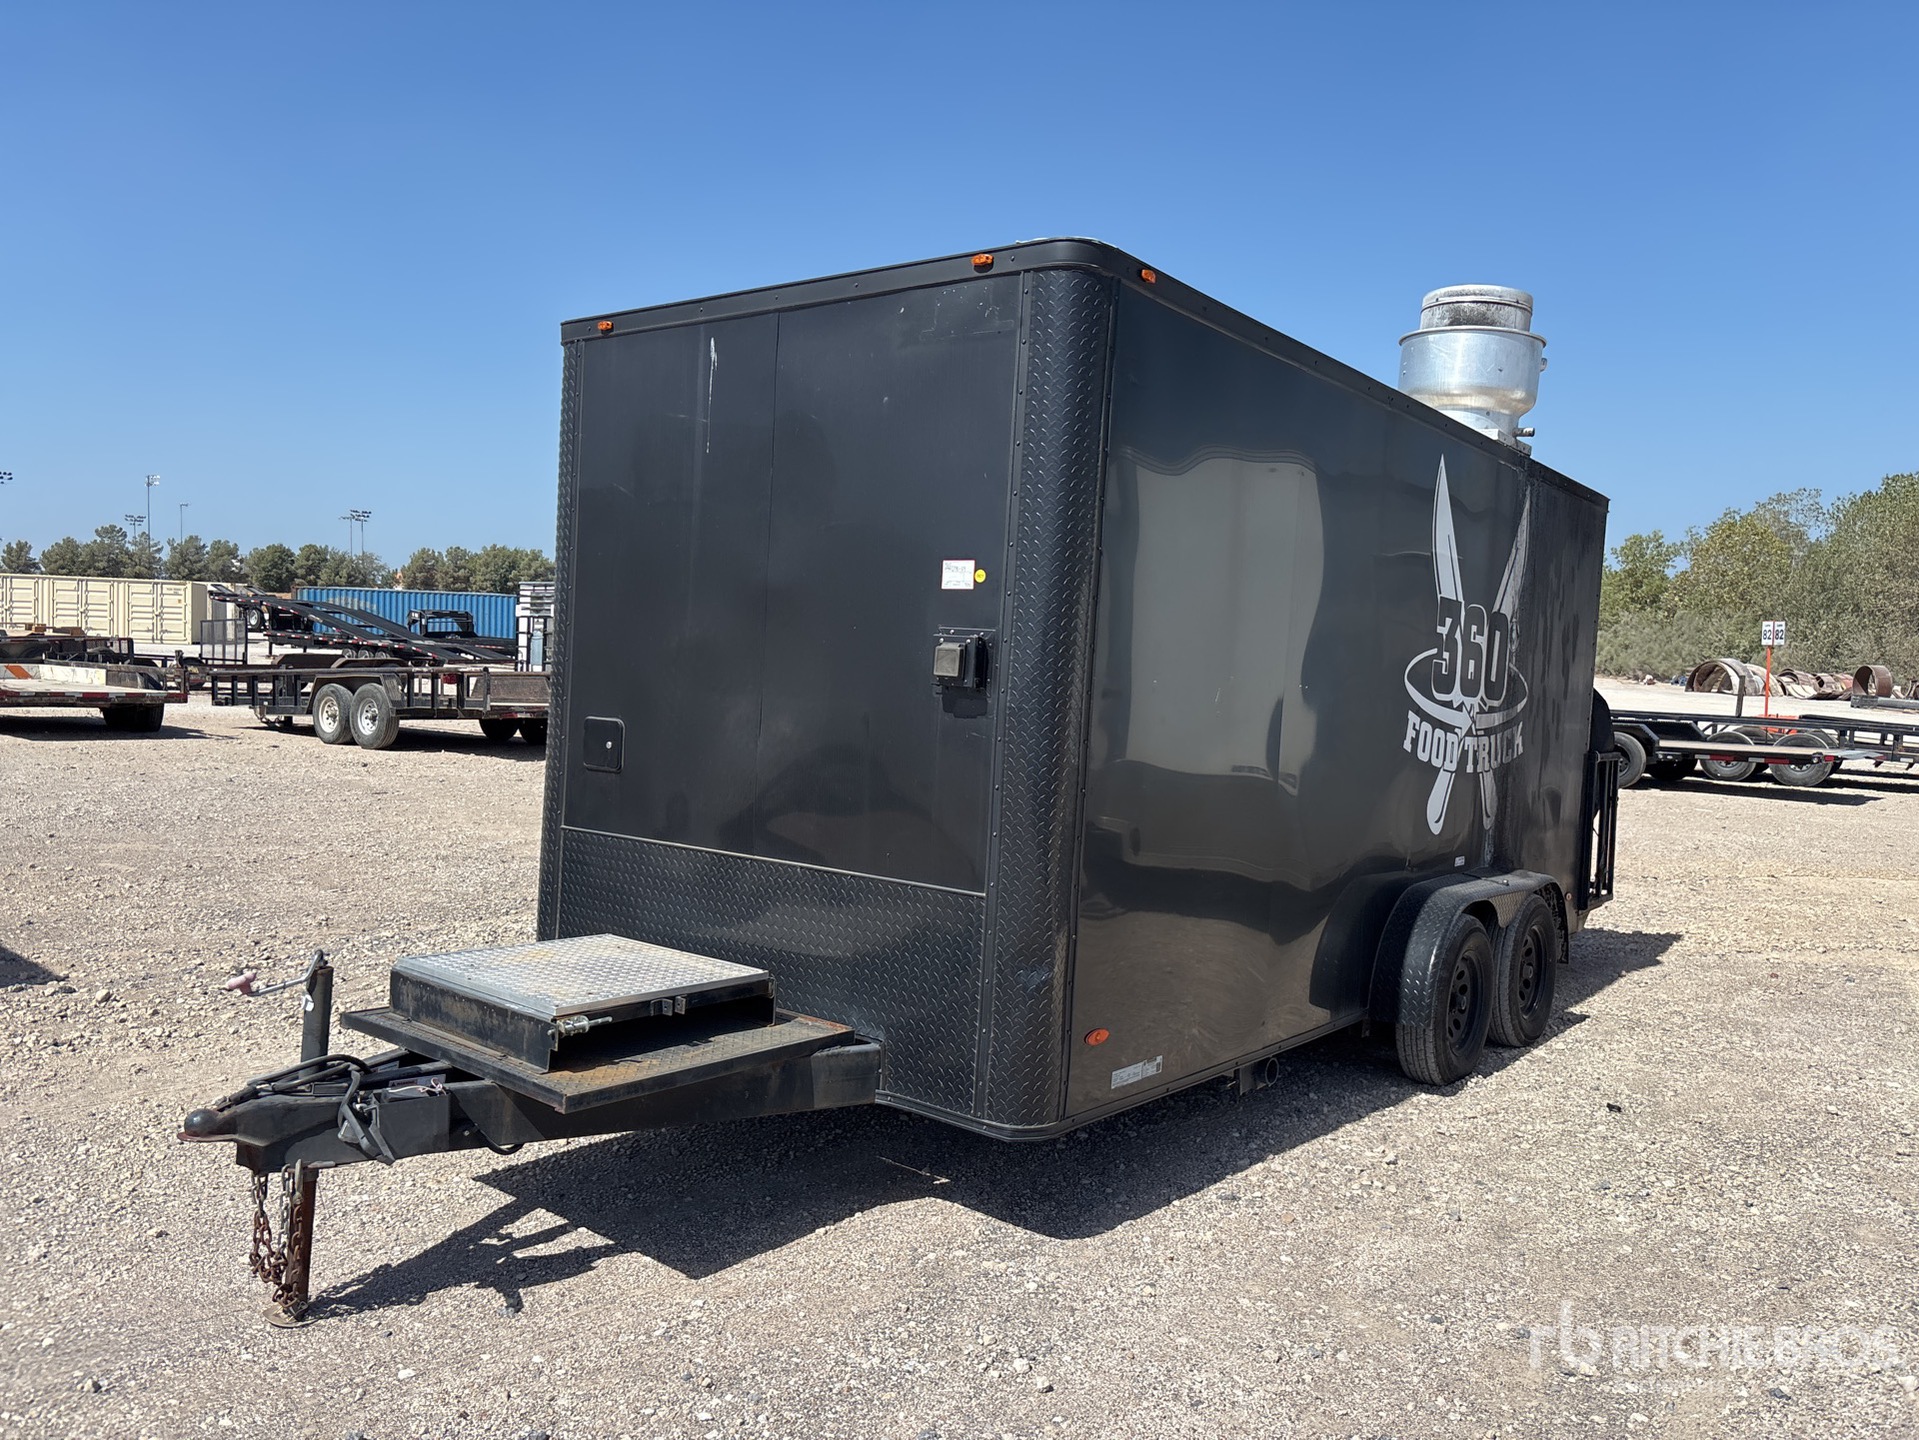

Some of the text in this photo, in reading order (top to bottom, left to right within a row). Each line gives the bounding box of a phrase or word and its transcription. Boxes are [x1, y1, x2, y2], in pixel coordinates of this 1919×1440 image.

[1431, 595, 1509, 701] 360
[1763, 629, 1772, 640] 82
[1775, 629, 1784, 640] 82
[1403, 710, 1524, 773] FOOD TRUCK
